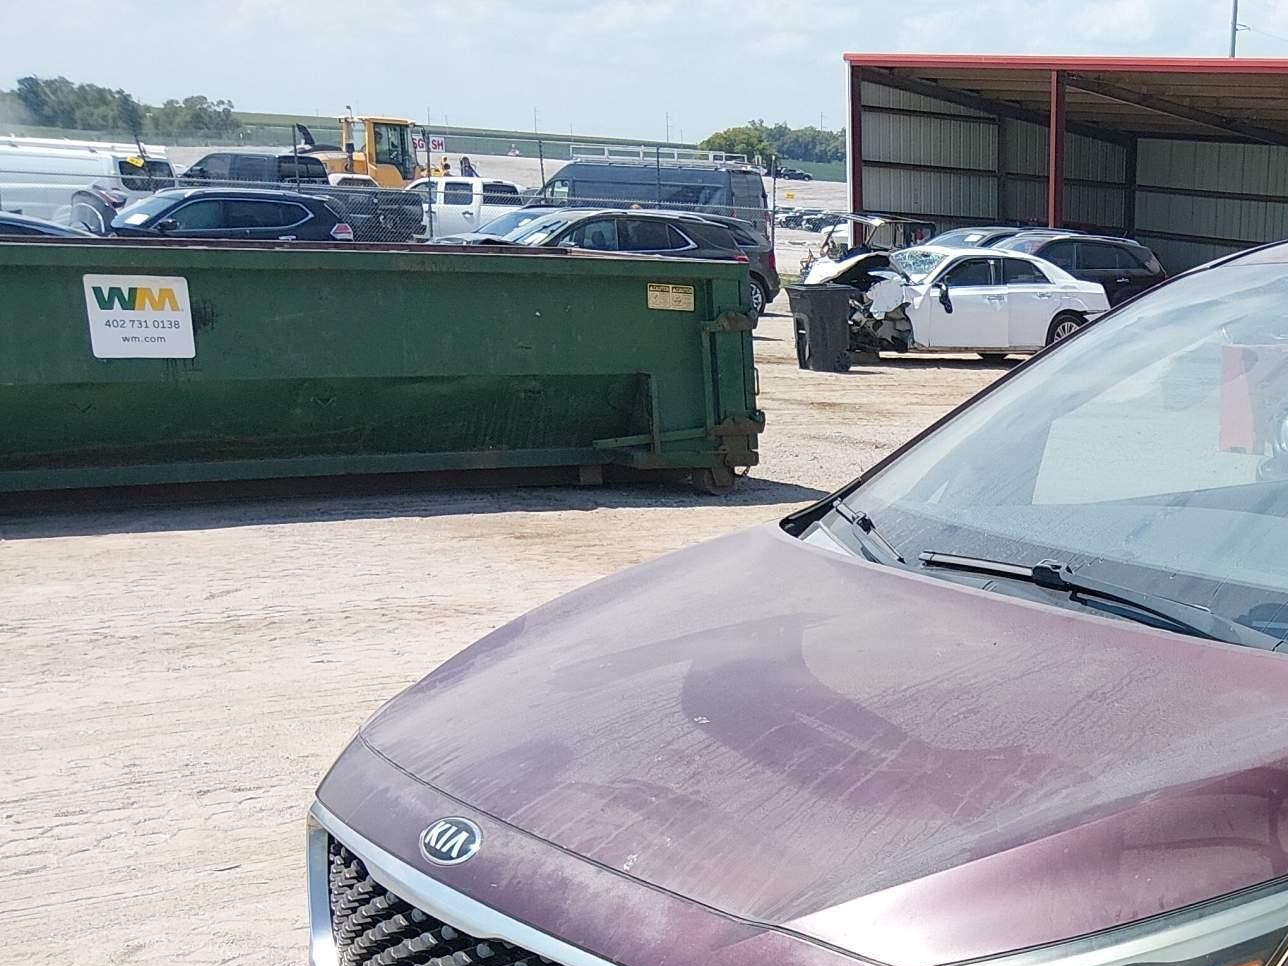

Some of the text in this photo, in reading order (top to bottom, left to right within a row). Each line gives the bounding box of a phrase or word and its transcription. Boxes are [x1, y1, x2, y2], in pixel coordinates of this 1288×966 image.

[91, 286, 181, 312] WM
[104, 319, 181, 330] 402 731 0138
[121, 335, 166, 343] wm.com
[424, 820, 470, 858] KIA
